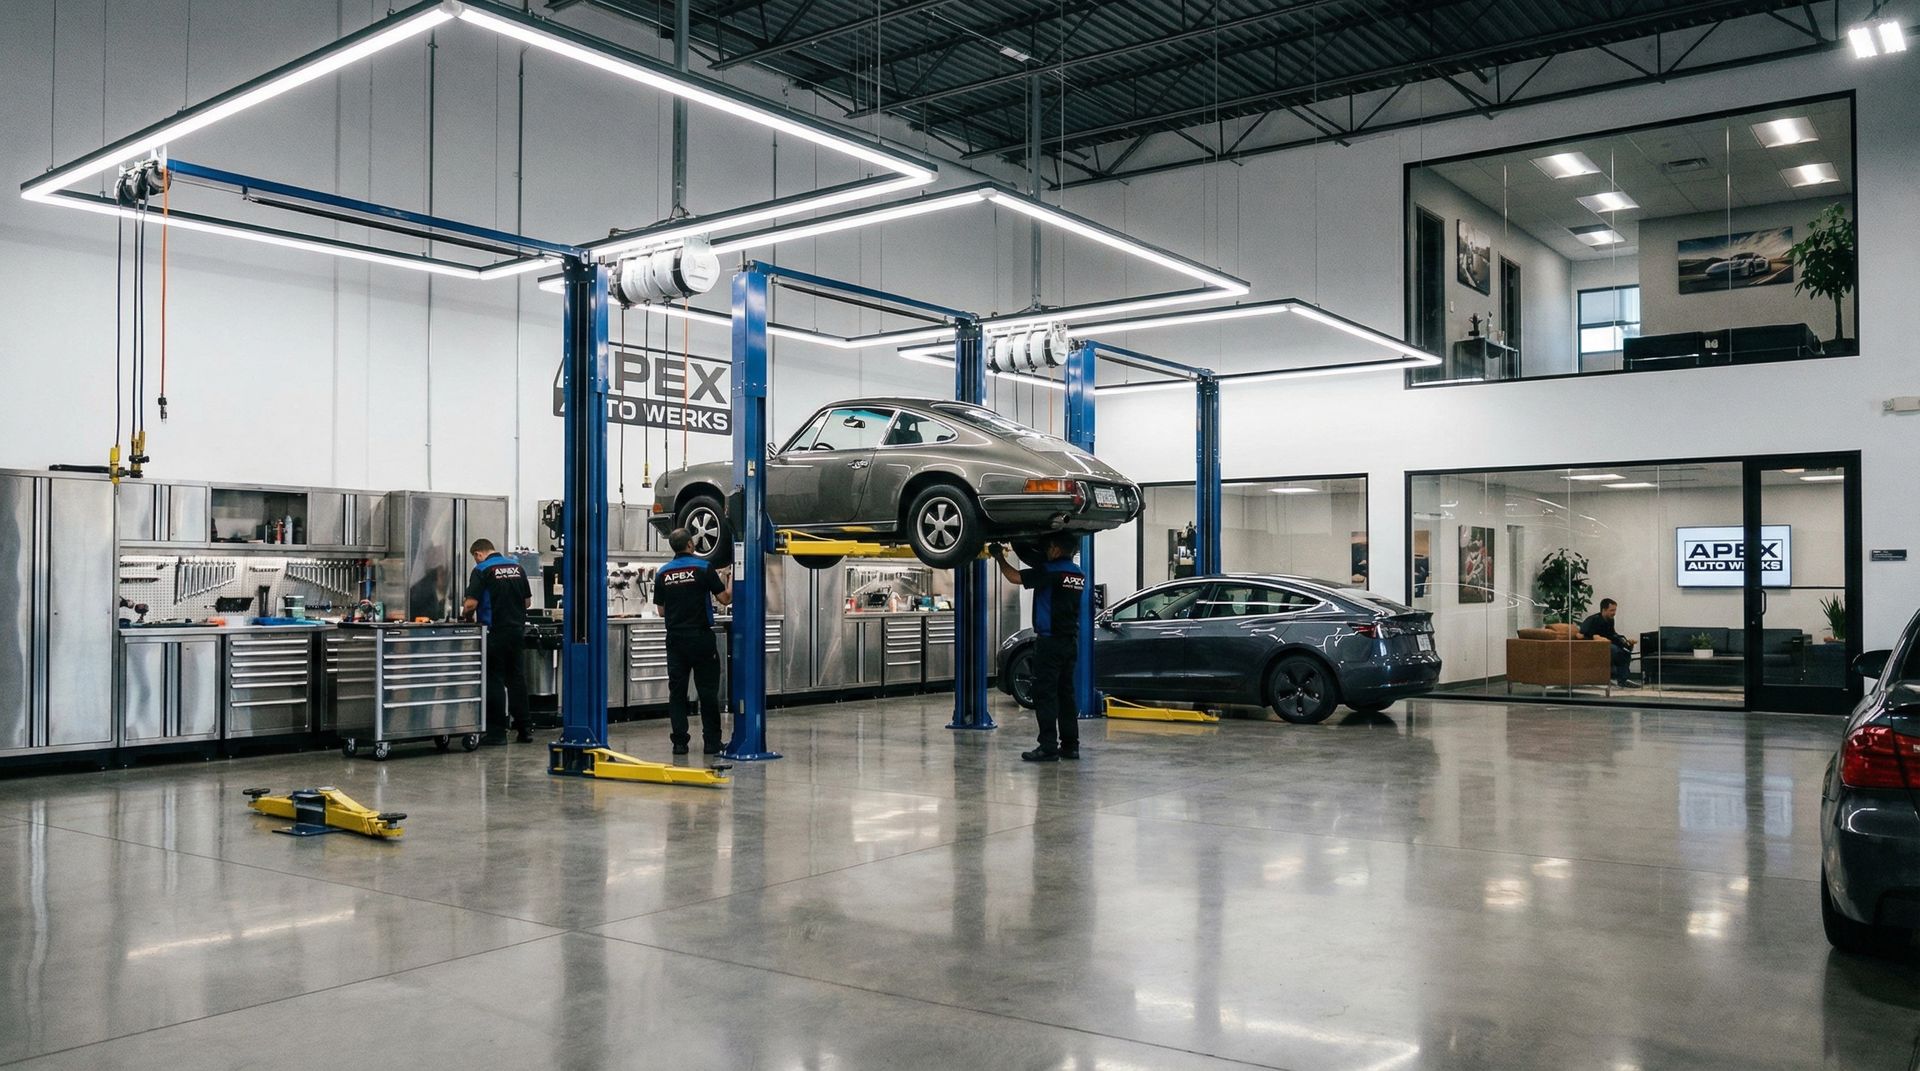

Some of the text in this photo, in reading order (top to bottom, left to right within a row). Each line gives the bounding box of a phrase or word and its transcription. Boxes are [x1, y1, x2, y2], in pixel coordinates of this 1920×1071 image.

[608, 350, 728, 404] PEX
[643, 403, 728, 431] WERKS
[1687, 561, 1780, 570] AUTO WKS
